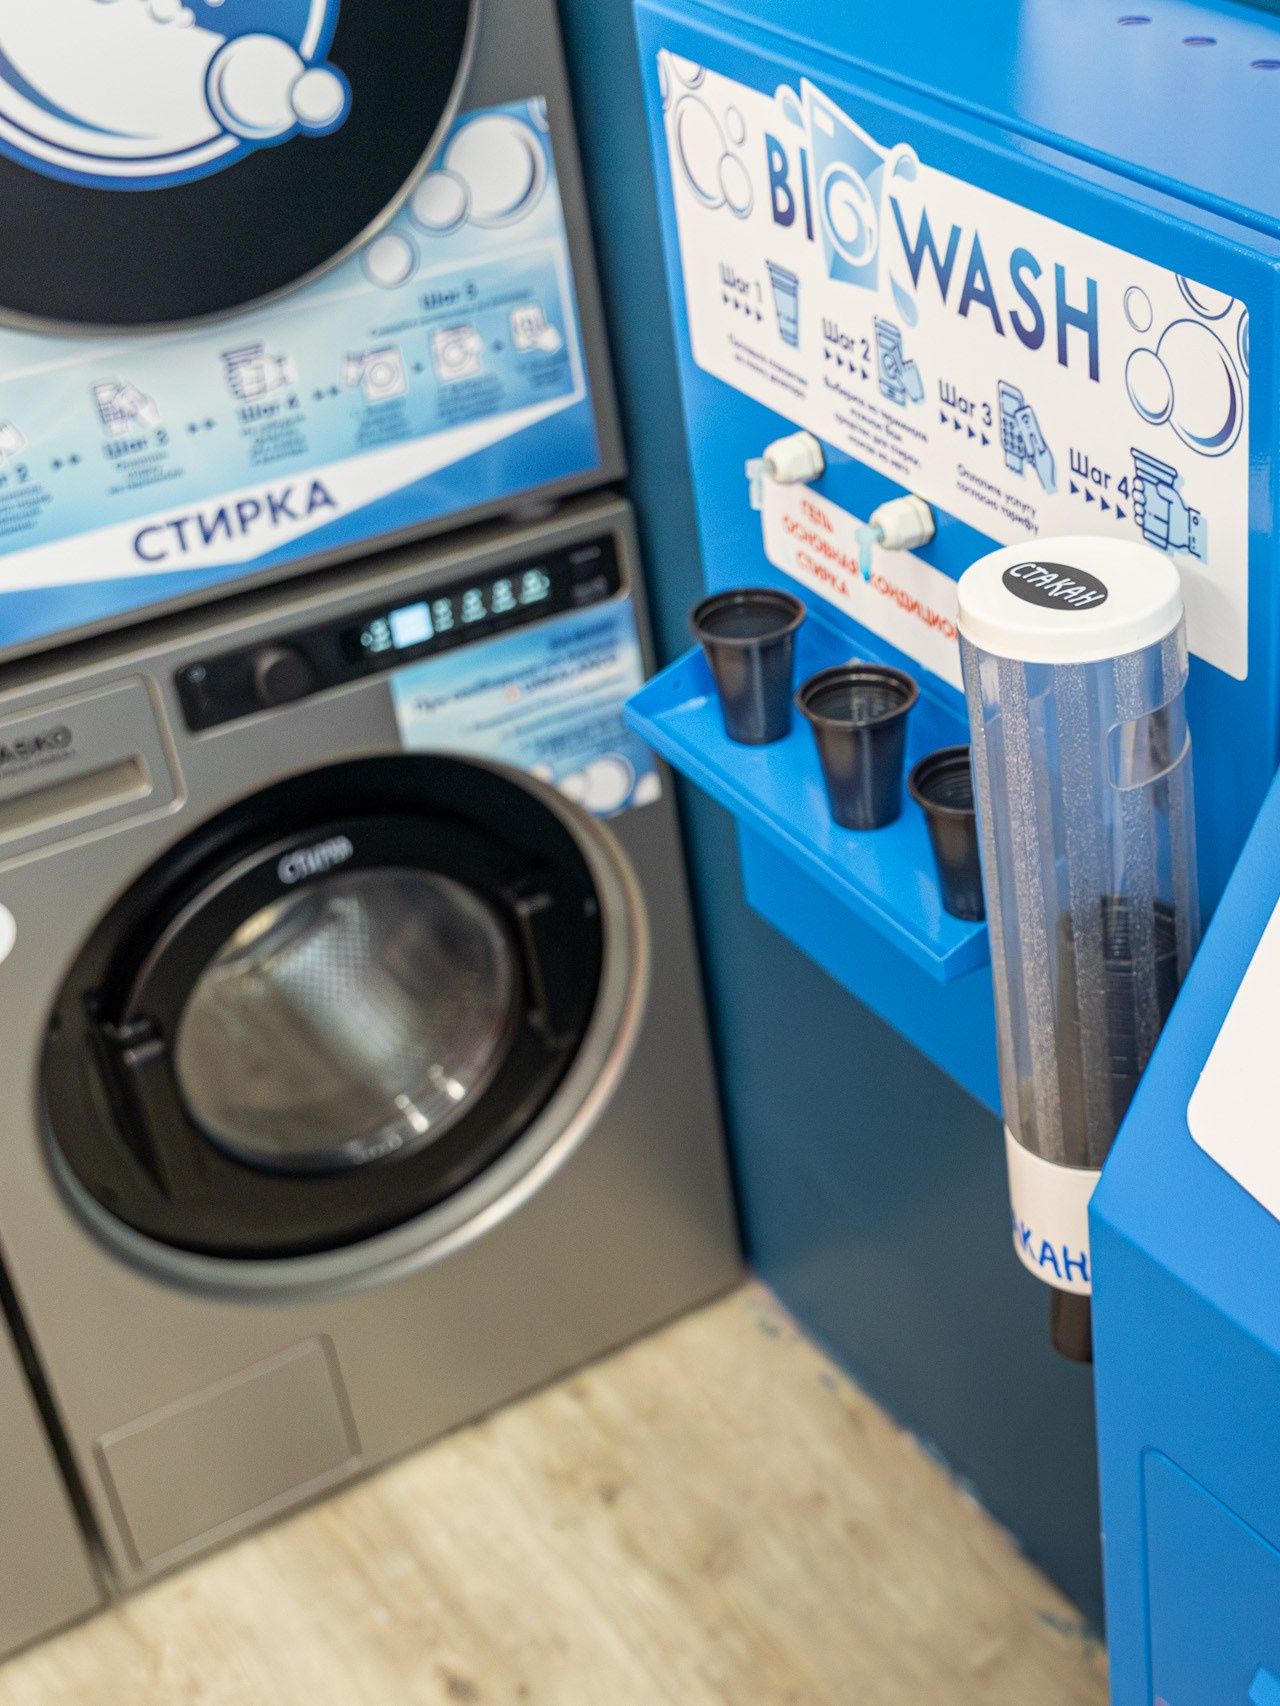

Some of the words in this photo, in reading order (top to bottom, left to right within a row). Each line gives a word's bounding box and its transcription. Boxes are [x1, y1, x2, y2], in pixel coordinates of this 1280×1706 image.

[719, 261, 749, 294] Шаг
[889, 194, 1100, 384] WASH
[822, 316, 854, 351] Шаг
[860, 338, 871, 362] 2
[939, 379, 976, 417] Шаг
[981, 403, 992, 427] 3
[1070, 447, 1111, 489] Шаг
[1117, 476, 1130, 501] 4
[133, 479, 337, 564] СТИРКА
[1009, 563, 1105, 607] СТАКАН
